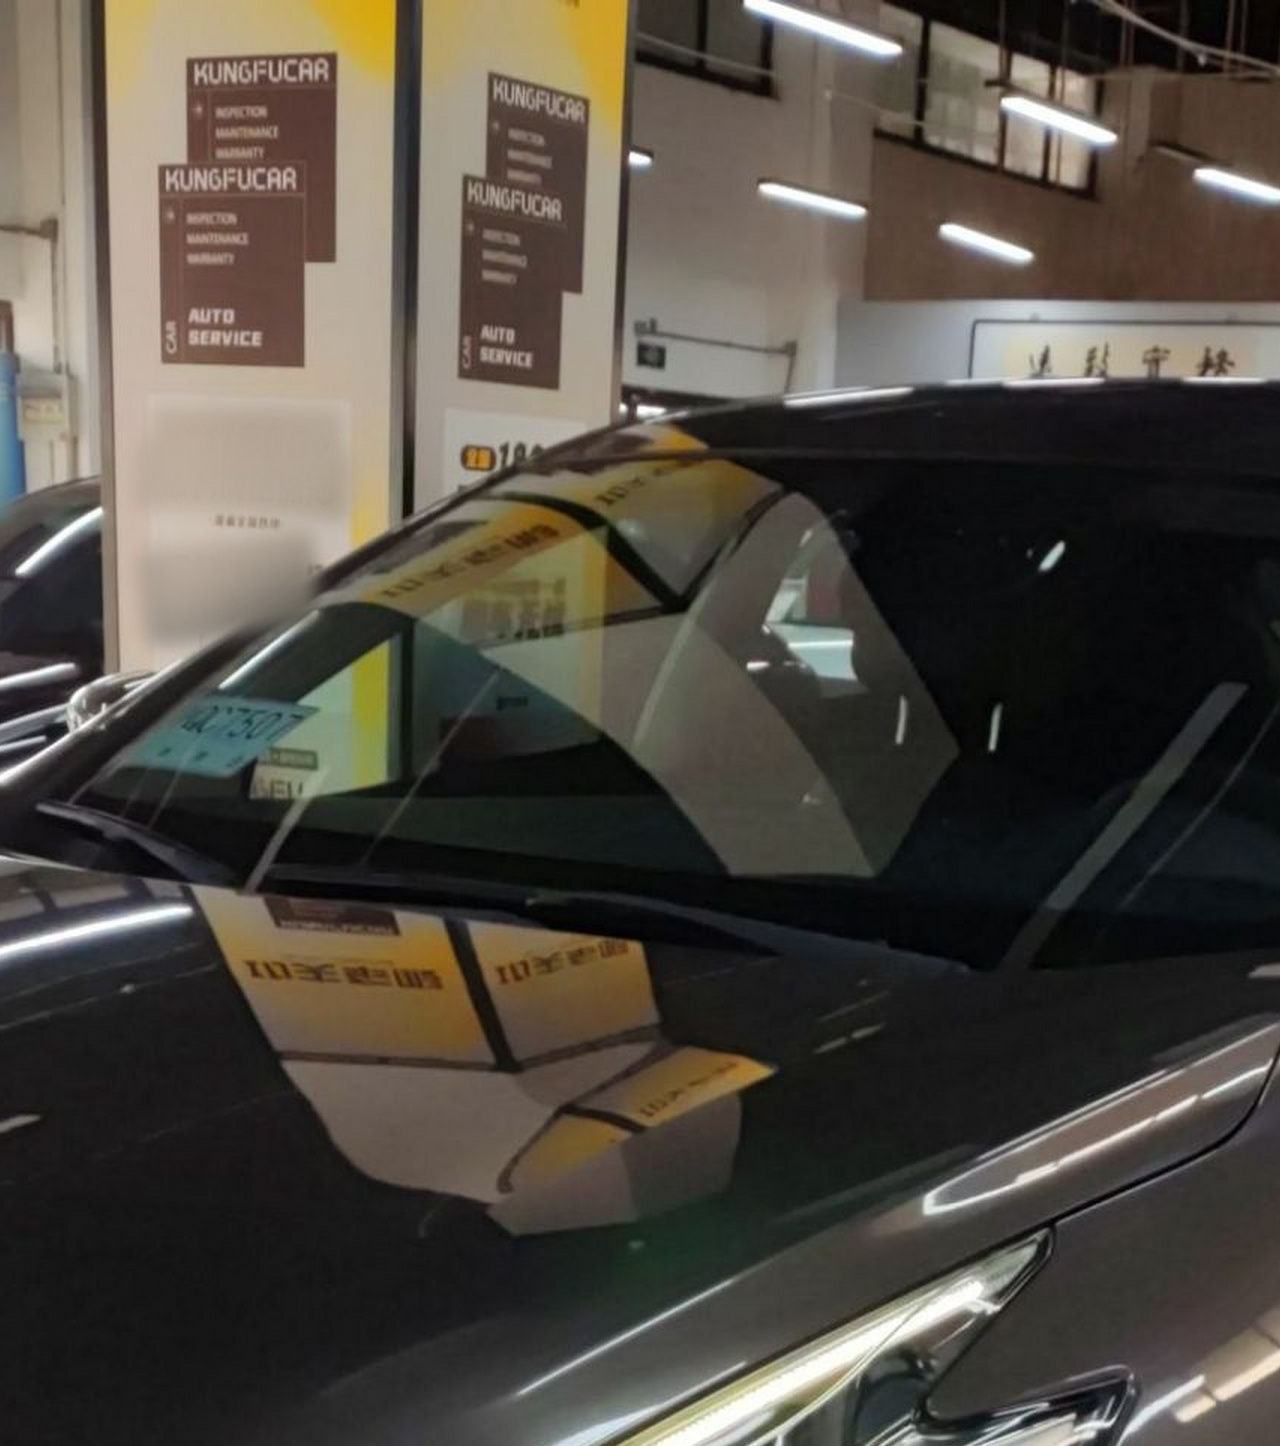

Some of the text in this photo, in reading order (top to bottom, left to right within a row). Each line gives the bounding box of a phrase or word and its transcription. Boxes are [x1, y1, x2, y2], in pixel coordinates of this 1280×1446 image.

[193, 58, 329, 86] KUNGFUCAR
[493, 79, 586, 123] KUNGFUCAR
[165, 166, 297, 193] KUNGFUCAR
[467, 180, 562, 221] KUNGFUCAR
[188, 308, 236, 324] AUTO
[165, 321, 178, 355] CAR
[188, 329, 263, 347] SERVICE
[480, 324, 516, 345] AUTO
[480, 346, 533, 369] SERVICE
